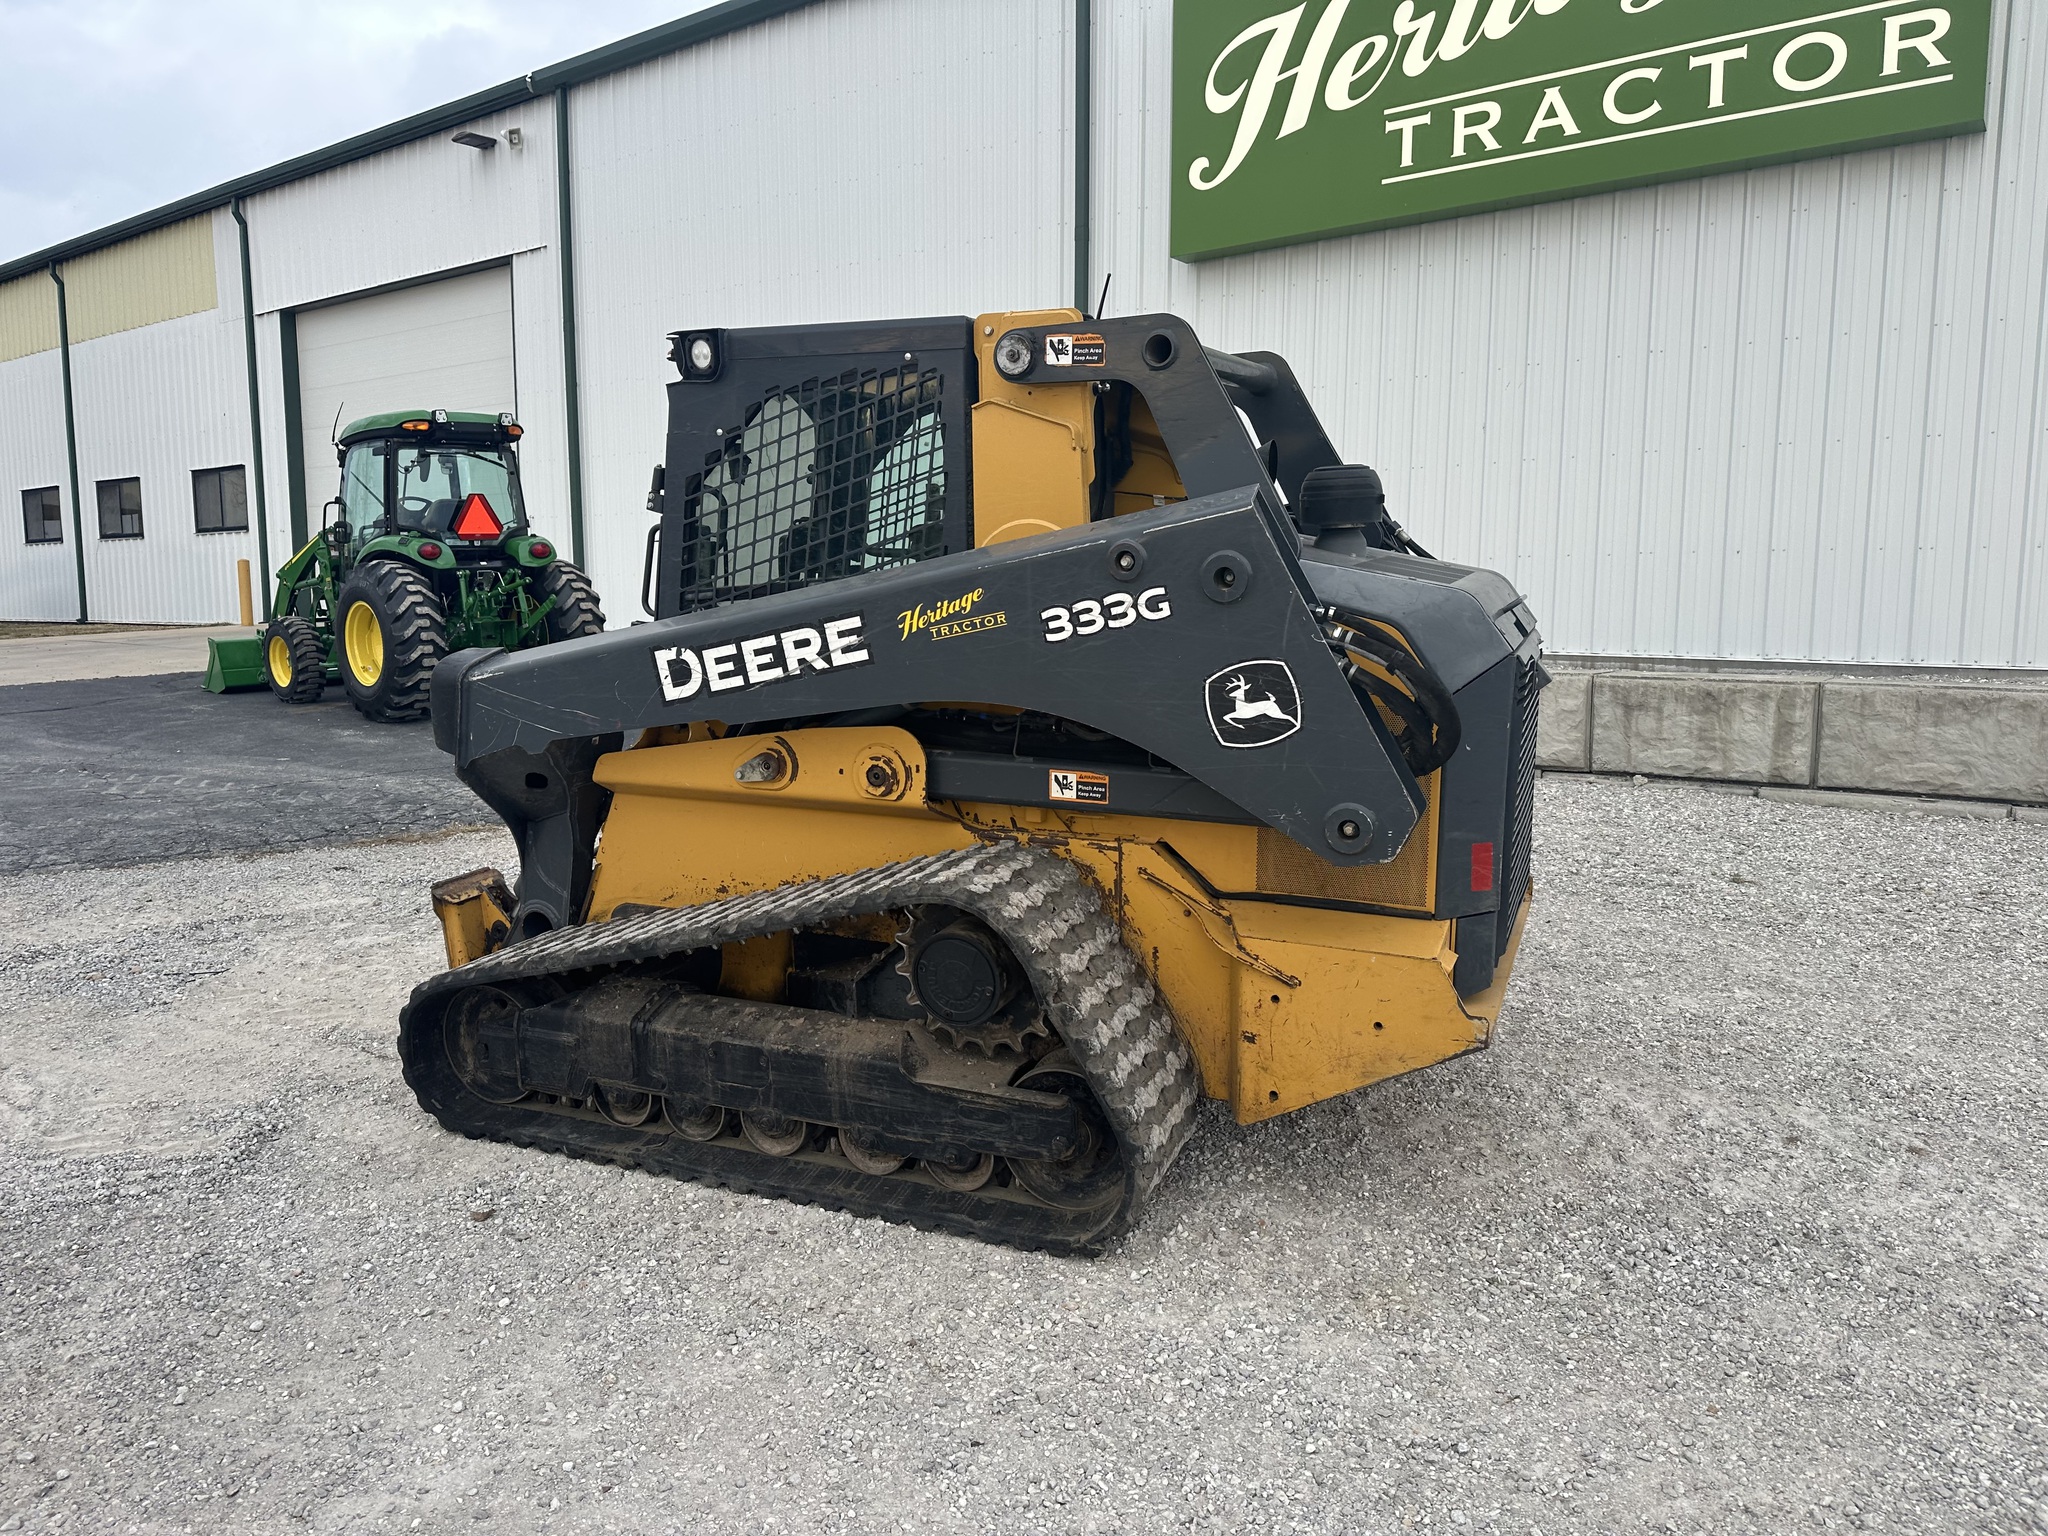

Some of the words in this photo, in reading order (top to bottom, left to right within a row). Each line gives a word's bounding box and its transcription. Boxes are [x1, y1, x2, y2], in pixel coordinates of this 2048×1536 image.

[1385, 7, 1951, 167] TRACTOR
[897, 587, 984, 641] Heritage
[929, 614, 1006, 638] TRACTOR
[1041, 587, 1171, 642] 333G
[654, 615, 870, 702] DEERE
